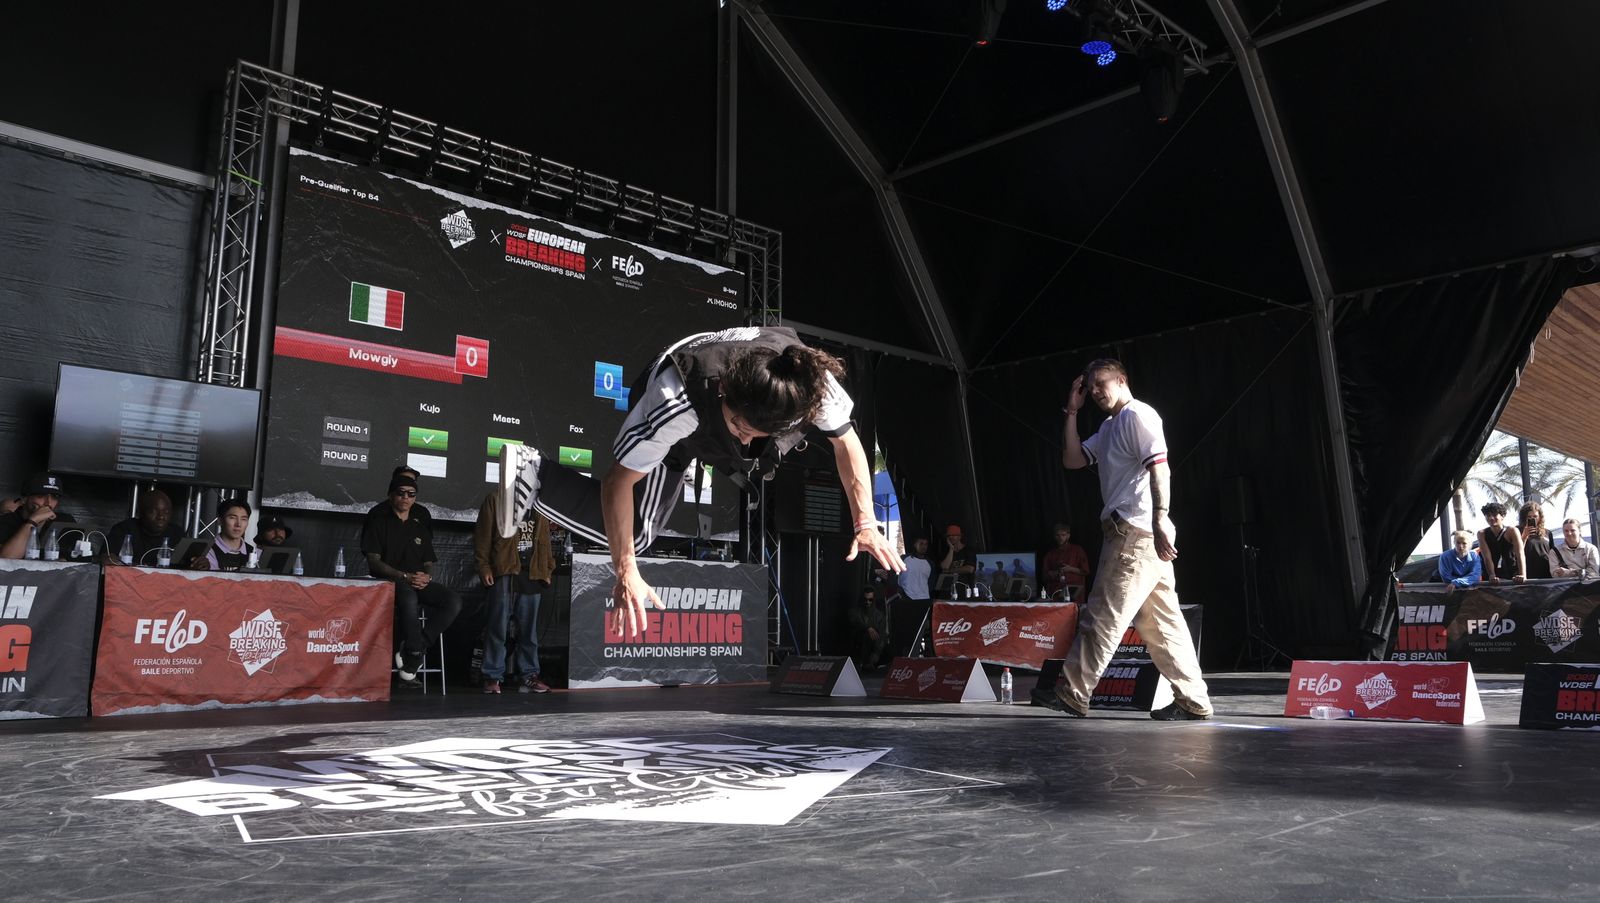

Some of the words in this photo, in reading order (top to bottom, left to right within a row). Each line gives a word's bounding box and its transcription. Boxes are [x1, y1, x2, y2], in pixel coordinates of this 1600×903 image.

[300, 174, 350, 193] Pre-Qualifier
[352, 188, 367, 199] Top
[447, 213, 472, 229] WDSF
[506, 229, 527, 239] WDSF
[526, 228, 586, 255] EUROPEAN
[505, 235, 586, 273] BREAKING
[504, 255, 564, 275] CHAMPIONSHIPS
[564, 269, 586, 280] SPAIN
[465, 346, 479, 367] 0
[603, 372, 614, 391] 0
[326, 422, 361, 434] ROUND
[363, 427, 368, 435] 1
[569, 424, 584, 434] Fox
[323, 450, 358, 462] ROUND
[360, 454, 367, 463] 2
[1540, 616, 1575, 629] WDSF
[241, 620, 282, 638] WDSF
[307, 628, 325, 639] world
[1534, 628, 1583, 637] BREAKING
[1019, 631, 1056, 643] DanceSport
[229, 638, 286, 650] BREAKING
[306, 640, 360, 654] DanceSport
[603, 646, 707, 659] CHAMPIONSHIPS
[710, 646, 743, 657] SPAIN
[1410, 652, 1448, 661] SPAIN
[133, 657, 171, 666] FEDERACIÓN
[172, 656, 203, 666] ESPAÑOLA
[333, 654, 360, 665] federation
[161, 667, 195, 675] DEPORTIVO
[1364, 679, 1392, 689] WDSF
[1559, 681, 1593, 689] WDSF
[1356, 688, 1397, 696] BREAKING
[1412, 691, 1461, 700] DanceSport
[1110, 695, 1133, 703] SPAIN
[470, 788, 598, 817] for
